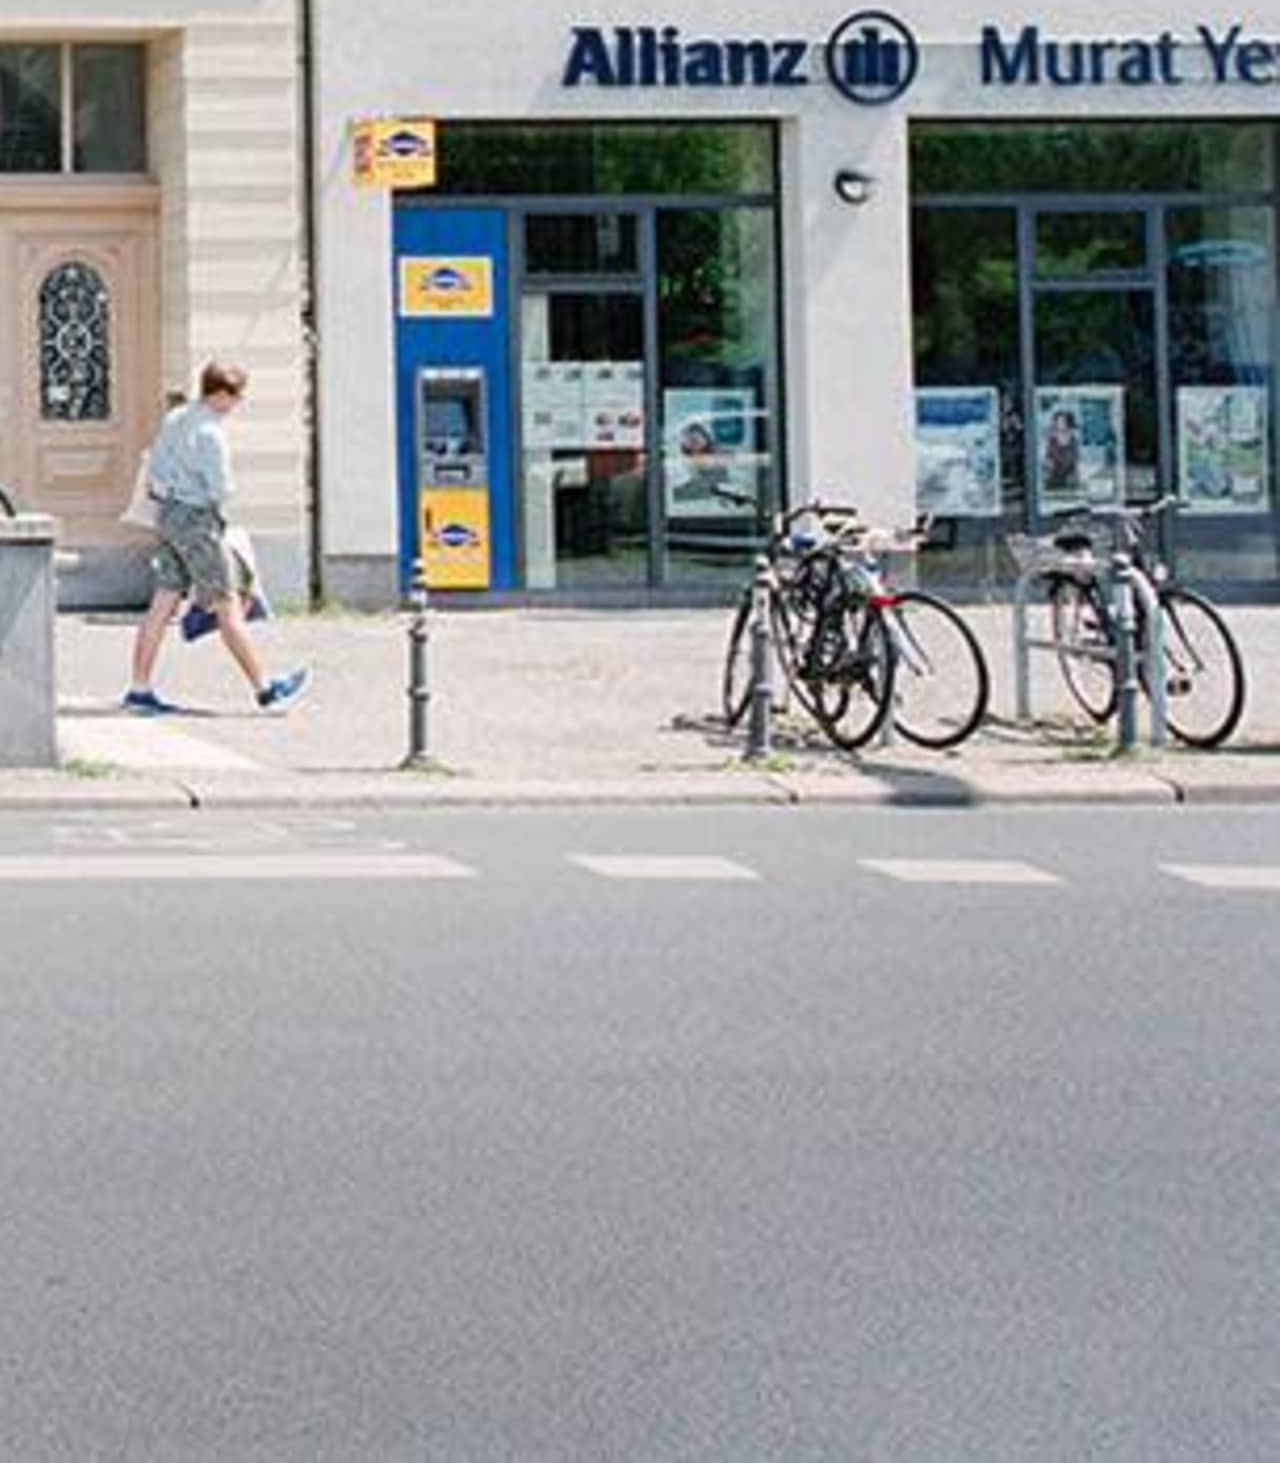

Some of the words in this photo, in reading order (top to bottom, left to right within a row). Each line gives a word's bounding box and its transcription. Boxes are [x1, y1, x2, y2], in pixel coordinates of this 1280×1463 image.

[562, 26, 809, 87] Allianz
[980, 26, 1183, 87] Murat
[1197, 24, 1280, 87] Ye
